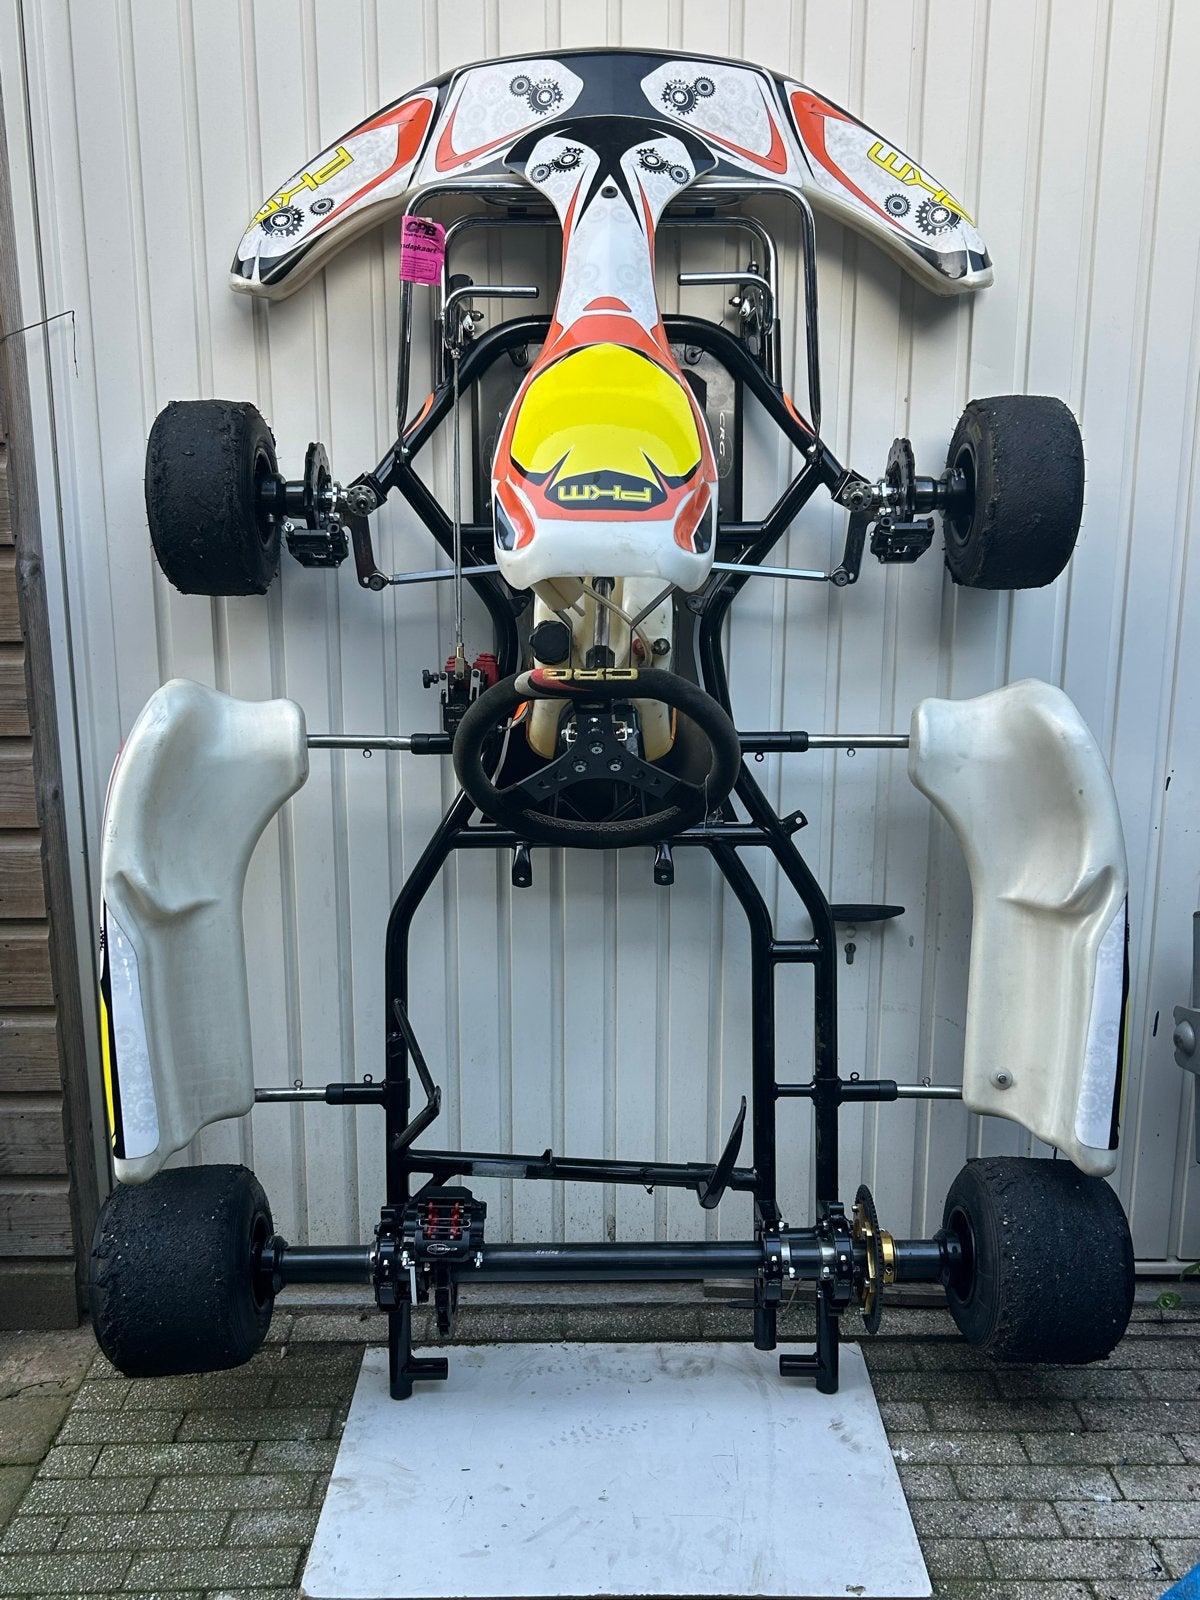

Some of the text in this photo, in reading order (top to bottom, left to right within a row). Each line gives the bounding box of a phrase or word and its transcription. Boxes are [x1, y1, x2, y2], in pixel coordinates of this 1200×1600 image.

[406, 221, 437, 237] CPB
[719, 412, 727, 457] CRG
[557, 484, 652, 504] PKM
[543, 668, 638, 682] CRG
